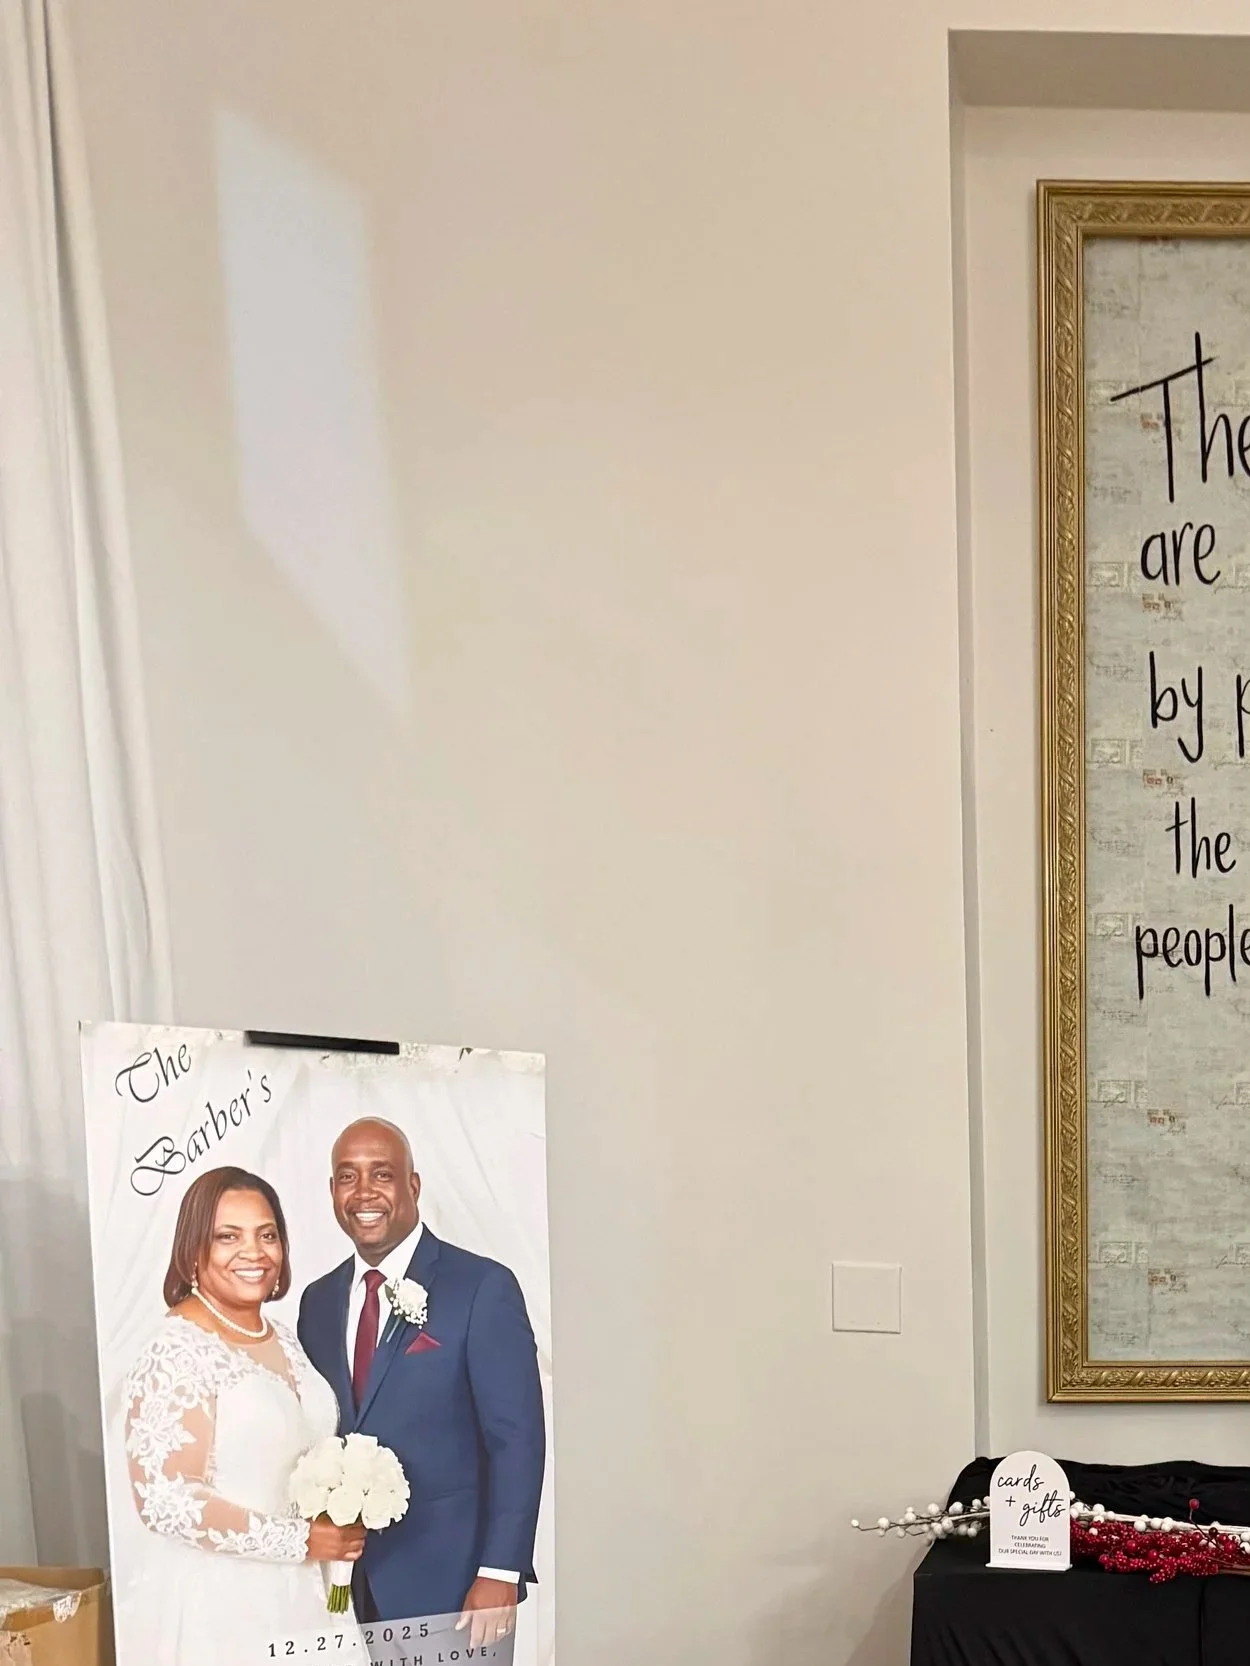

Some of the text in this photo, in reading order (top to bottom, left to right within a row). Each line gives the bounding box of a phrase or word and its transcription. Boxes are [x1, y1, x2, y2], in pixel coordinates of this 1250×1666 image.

[1140, 521, 1221, 586] are
[1149, 650, 1203, 763] by
[1164, 797, 1237, 878] the
[114, 1042, 192, 1104] The
[130, 1070, 273, 1197] Barber's
[997, 1464, 1045, 1493] cards
[1019, 1489, 1066, 1527] gifts
[268, 1622, 430, 1658] 12.27.2025
[438, 1646, 498, 1663] LOVE,
